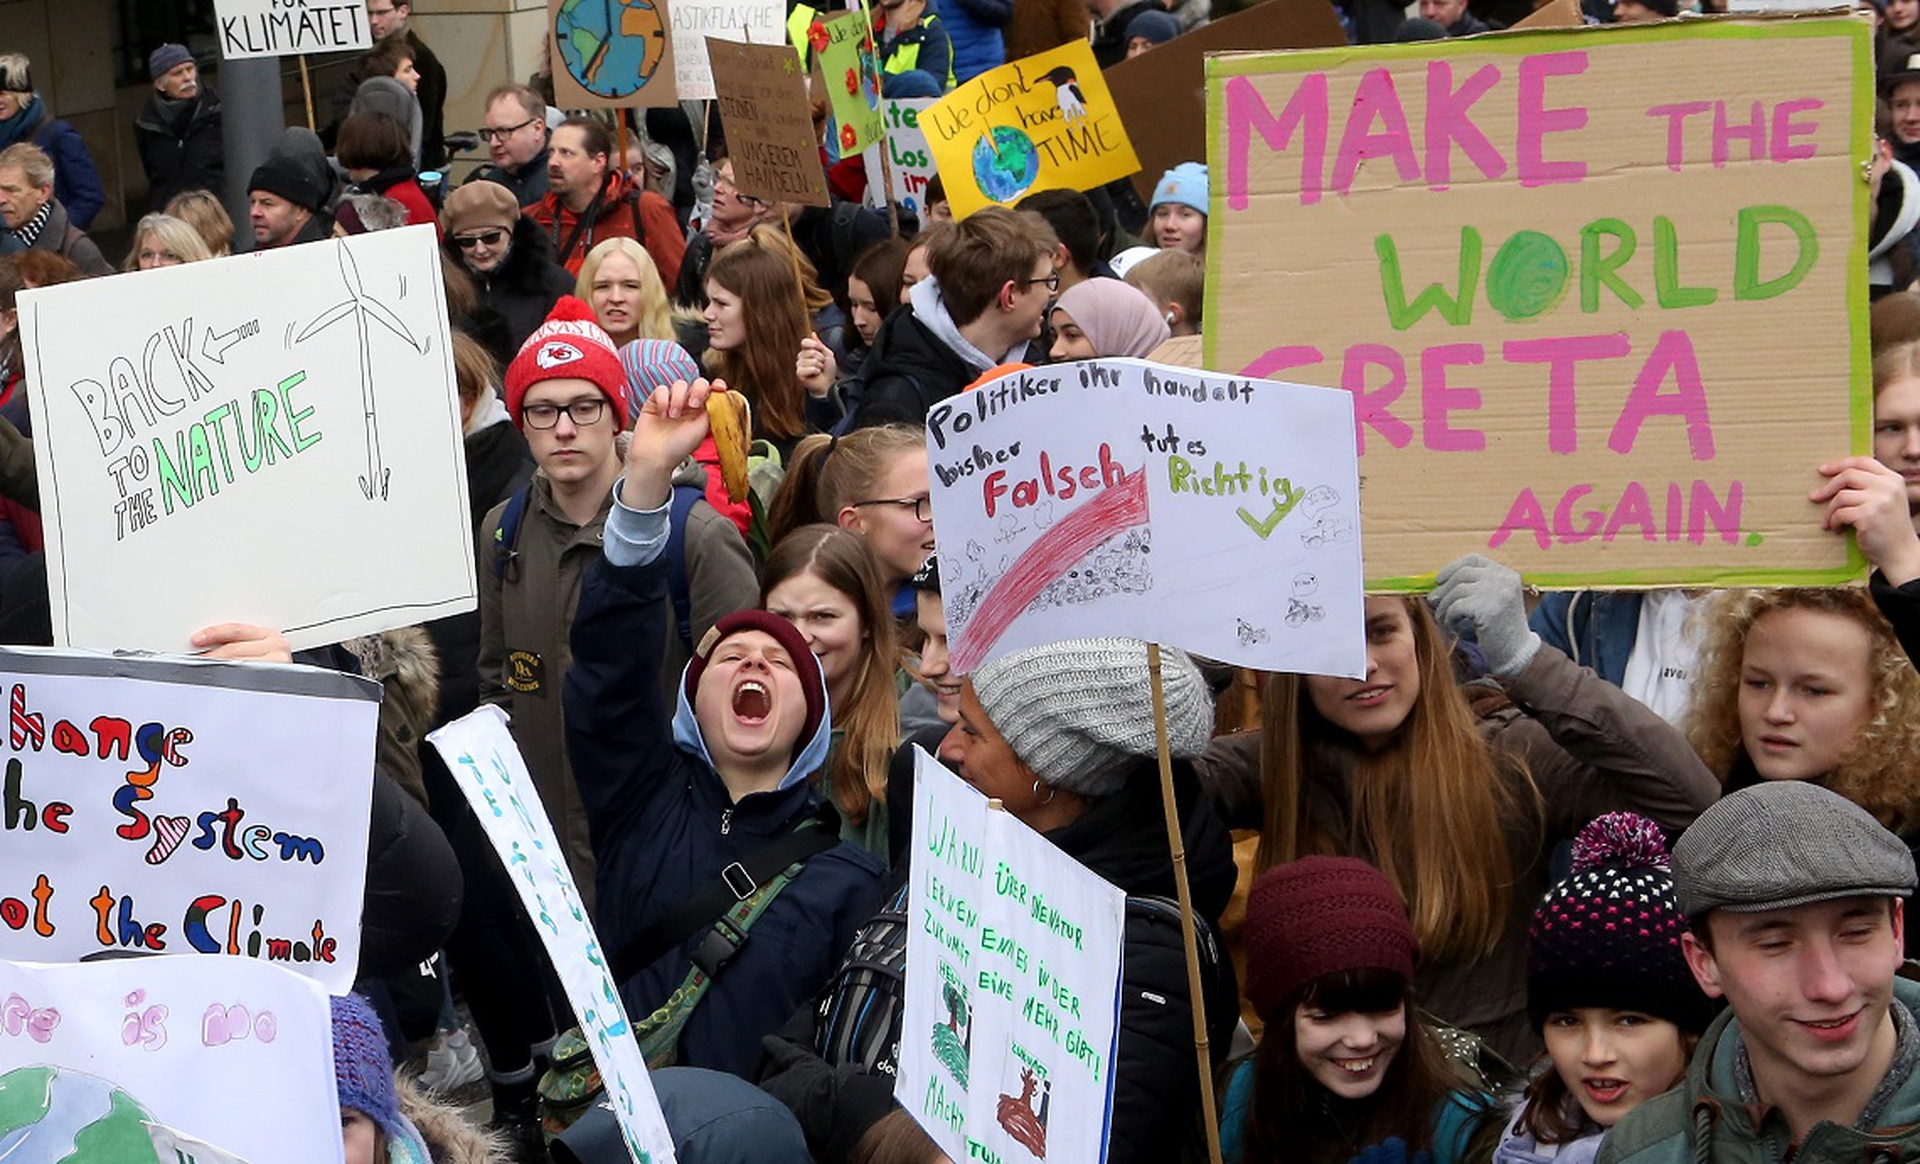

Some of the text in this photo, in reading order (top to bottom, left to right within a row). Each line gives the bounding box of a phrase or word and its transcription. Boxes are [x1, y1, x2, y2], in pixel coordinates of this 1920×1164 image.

[222, 5, 361, 53] KLIMATET
[884, 101, 918, 129] te
[933, 106, 975, 141] We
[1016, 104, 1064, 129] have
[1035, 113, 1119, 167] TIME
[1226, 52, 1825, 210] MAKE THE
[740, 140, 803, 168] UNSEREM
[744, 164, 810, 194] HANDELN
[1375, 205, 1820, 330] WORLD
[70, 317, 214, 457] BACK
[927, 362, 1255, 450] Politiker ihr handelt
[114, 369, 322, 541] THE NATURE
[934, 438, 1022, 488] bisher
[1140, 423, 1181, 455] tut
[107, 445, 149, 498] TO
[983, 443, 1127, 518] Falsch
[1168, 455, 1299, 508] Richtig
[1487, 479, 1764, 550] AGAIN.
[0, 683, 194, 787] hange
[3, 757, 325, 865] he System
[0, 874, 338, 964] ot the Climate
[0, 992, 61, 1044] re
[121, 987, 170, 1052] is
[1022, 996, 1061, 1045] MEHR
[1052, 977, 1083, 1021] DER
